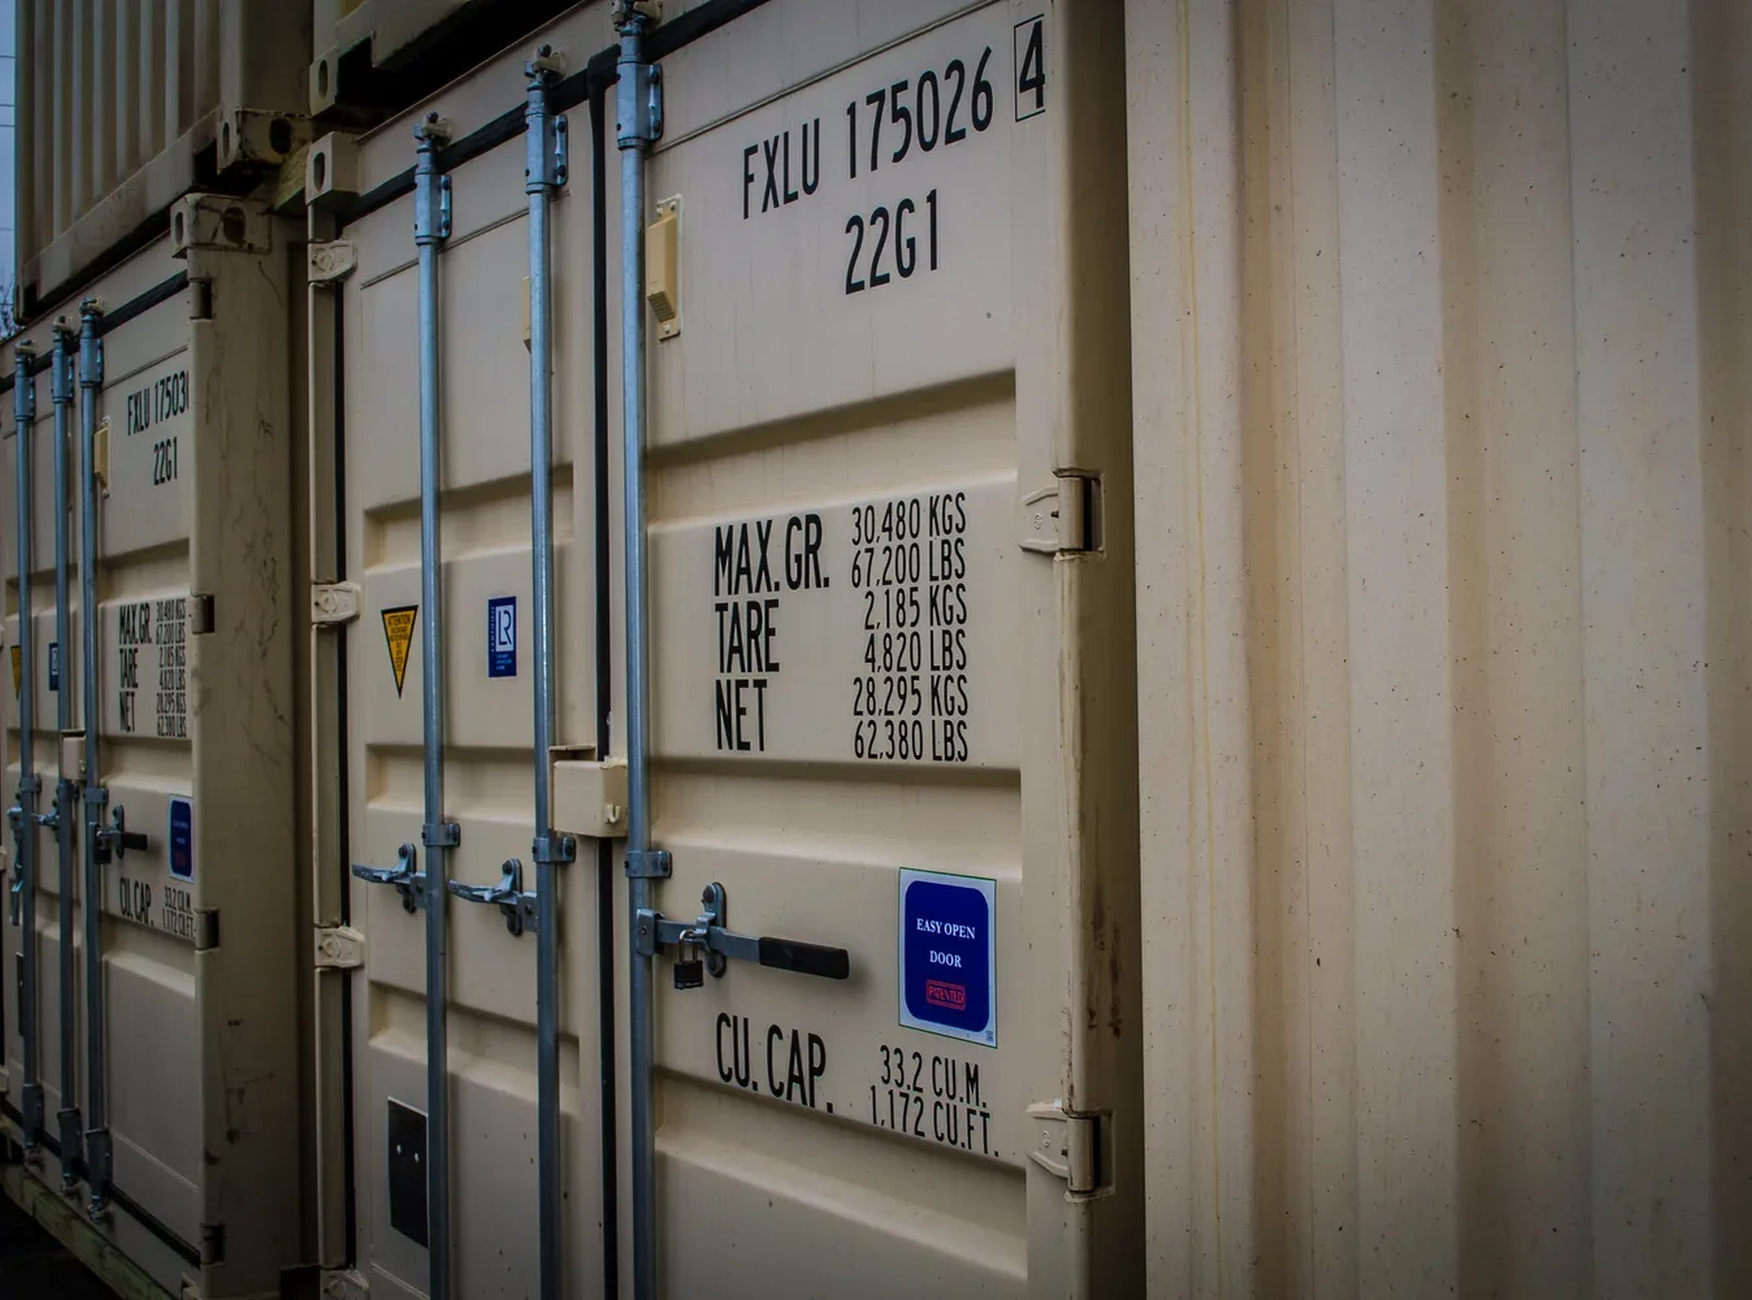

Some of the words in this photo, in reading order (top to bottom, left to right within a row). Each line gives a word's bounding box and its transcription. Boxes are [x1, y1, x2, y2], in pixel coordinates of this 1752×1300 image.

[743, 118, 820, 220] FXLU
[846, 46, 994, 180] 175026
[1019, 21, 1046, 109] 4
[845, 188, 937, 295] 22G1
[127, 387, 150, 436] FXLU
[154, 436, 177, 486] 22G1
[851, 498, 921, 546] 30,480
[929, 492, 967, 537] KGS
[851, 542, 921, 588] 67,200
[929, 538, 966, 582] LBS
[715, 599, 780, 673] TARE
[864, 587, 920, 630] 2,185
[929, 583, 967, 627] KGS
[864, 631, 921, 673] 4,820
[930, 629, 967, 672] LBS
[120, 648, 138, 688] TARE
[120, 691, 135, 732] NET
[715, 679, 768, 752] NET
[853, 676, 922, 716] 28,295
[931, 674, 968, 717] KGS
[854, 720, 923, 760] 62,380
[932, 720, 969, 762] LBS
[916, 918, 945, 935] EASY
[944, 922, 976, 940] OPEN
[929, 950, 962, 968] DOOR
[928, 985, 965, 1004] PATENTED
[716, 1012, 758, 1092] CU.
[766, 1024, 833, 1114] CAP.
[879, 1045, 924, 1093] 33.2
[931, 1055, 987, 1108] CU.M.
[870, 1084, 925, 1137] 1,172
[933, 1100, 999, 1157] CU.FT.
